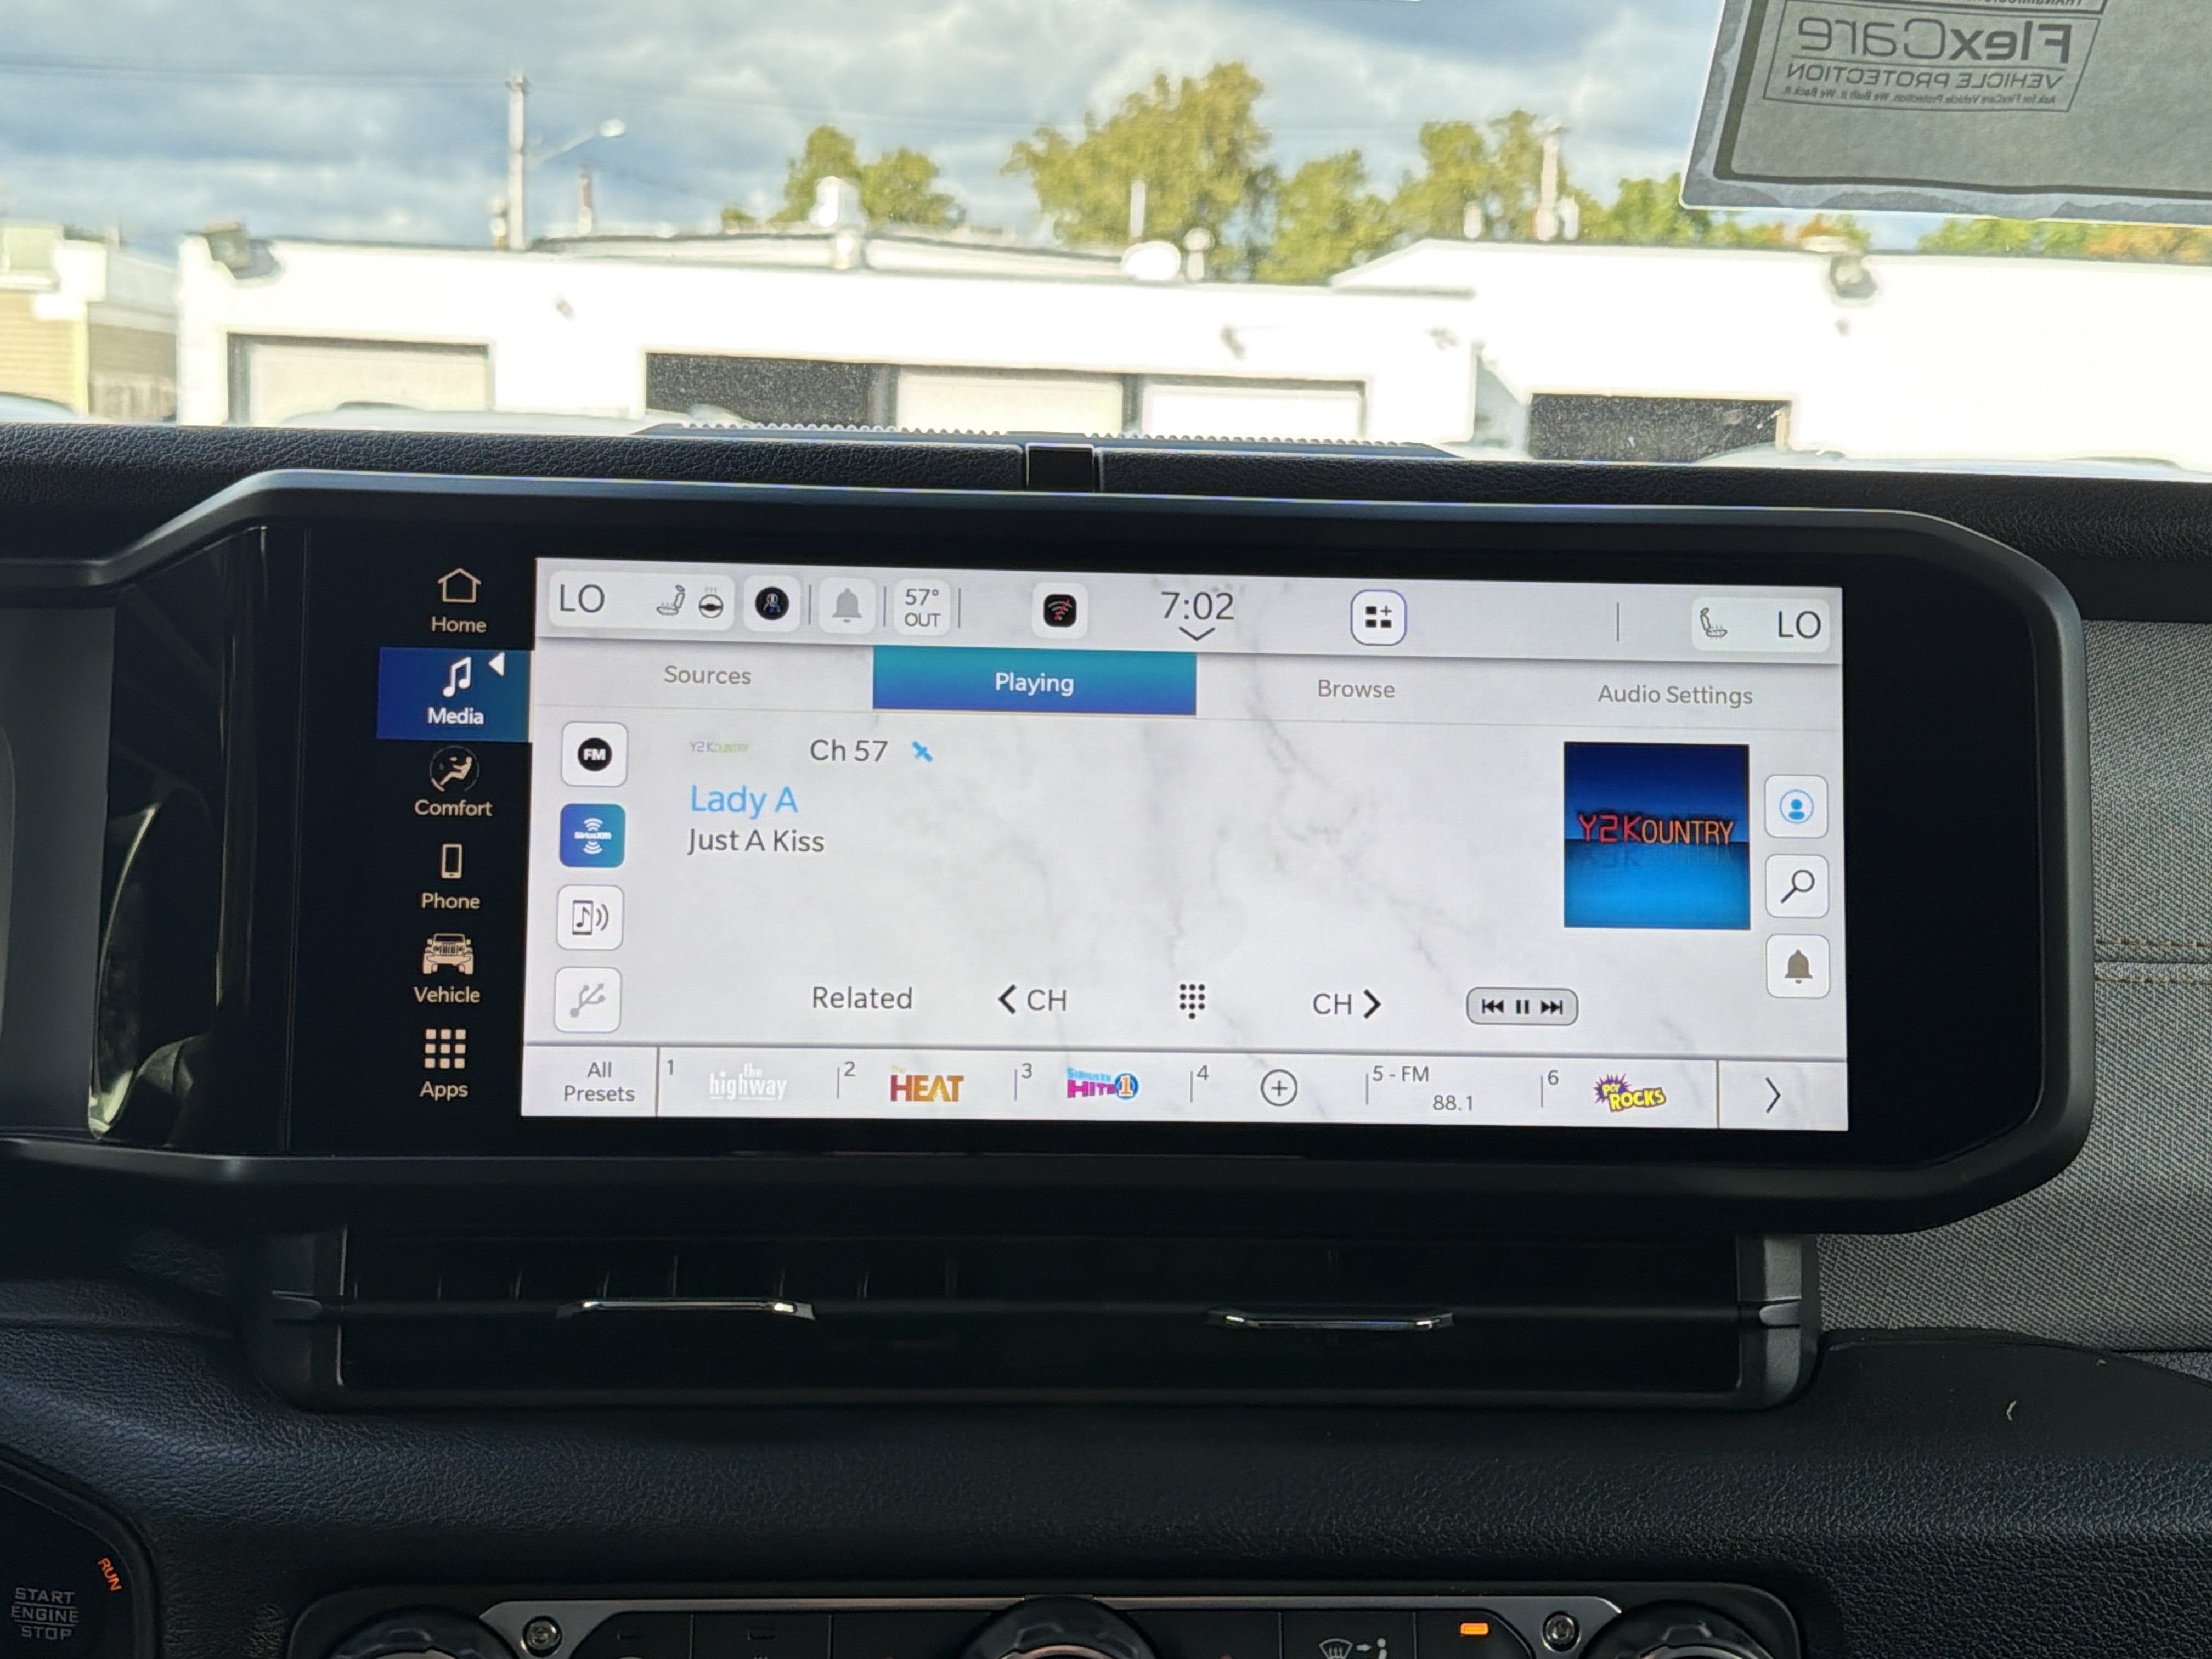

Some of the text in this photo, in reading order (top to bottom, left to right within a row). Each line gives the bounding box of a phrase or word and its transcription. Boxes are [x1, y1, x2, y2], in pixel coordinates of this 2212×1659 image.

[560, 583, 605, 613] LO
[1161, 591, 1234, 620] 7:02
[431, 616, 487, 633] Home
[904, 612, 941, 627] OUT
[1778, 611, 1821, 639] LO
[663, 665, 752, 685] Sources
[995, 672, 1074, 696] Playing
[1318, 679, 1395, 698] Browse
[1598, 684, 1753, 709] Audio Settings
[427, 707, 484, 725] Media
[583, 748, 606, 761] FM
[810, 738, 888, 762] Ch 57
[414, 799, 493, 816] Comfort
[691, 785, 798, 820] Lady A
[687, 828, 825, 856] Just A Kiss
[421, 892, 481, 910] Phone
[413, 986, 481, 1003] Vehicle
[813, 986, 912, 1009] Related
[1027, 989, 1066, 1011] CH
[1313, 993, 1352, 1015] CH
[586, 1061, 612, 1078] All
[666, 1059, 674, 1076] 1
[743, 1063, 763, 1077] the
[844, 1060, 856, 1077] 2
[1021, 1063, 1032, 1079] 3
[1196, 1065, 1209, 1081] 4
[1402, 1066, 1429, 1082] FM
[709, 1070, 787, 1100] highway
[1547, 1069, 1559, 1086] 6
[419, 1081, 468, 1101] Apps
[564, 1085, 635, 1102] Presets
[890, 1075, 964, 1102] HEAT
[1432, 1094, 1473, 1112] 88.1
[1609, 1088, 1666, 1111] ROCKS
[97, 1557, 122, 1592] RUN
[15, 1587, 75, 1605] START
[11, 1605, 80, 1623] ENGINE
[21, 1625, 72, 1641] STOP
